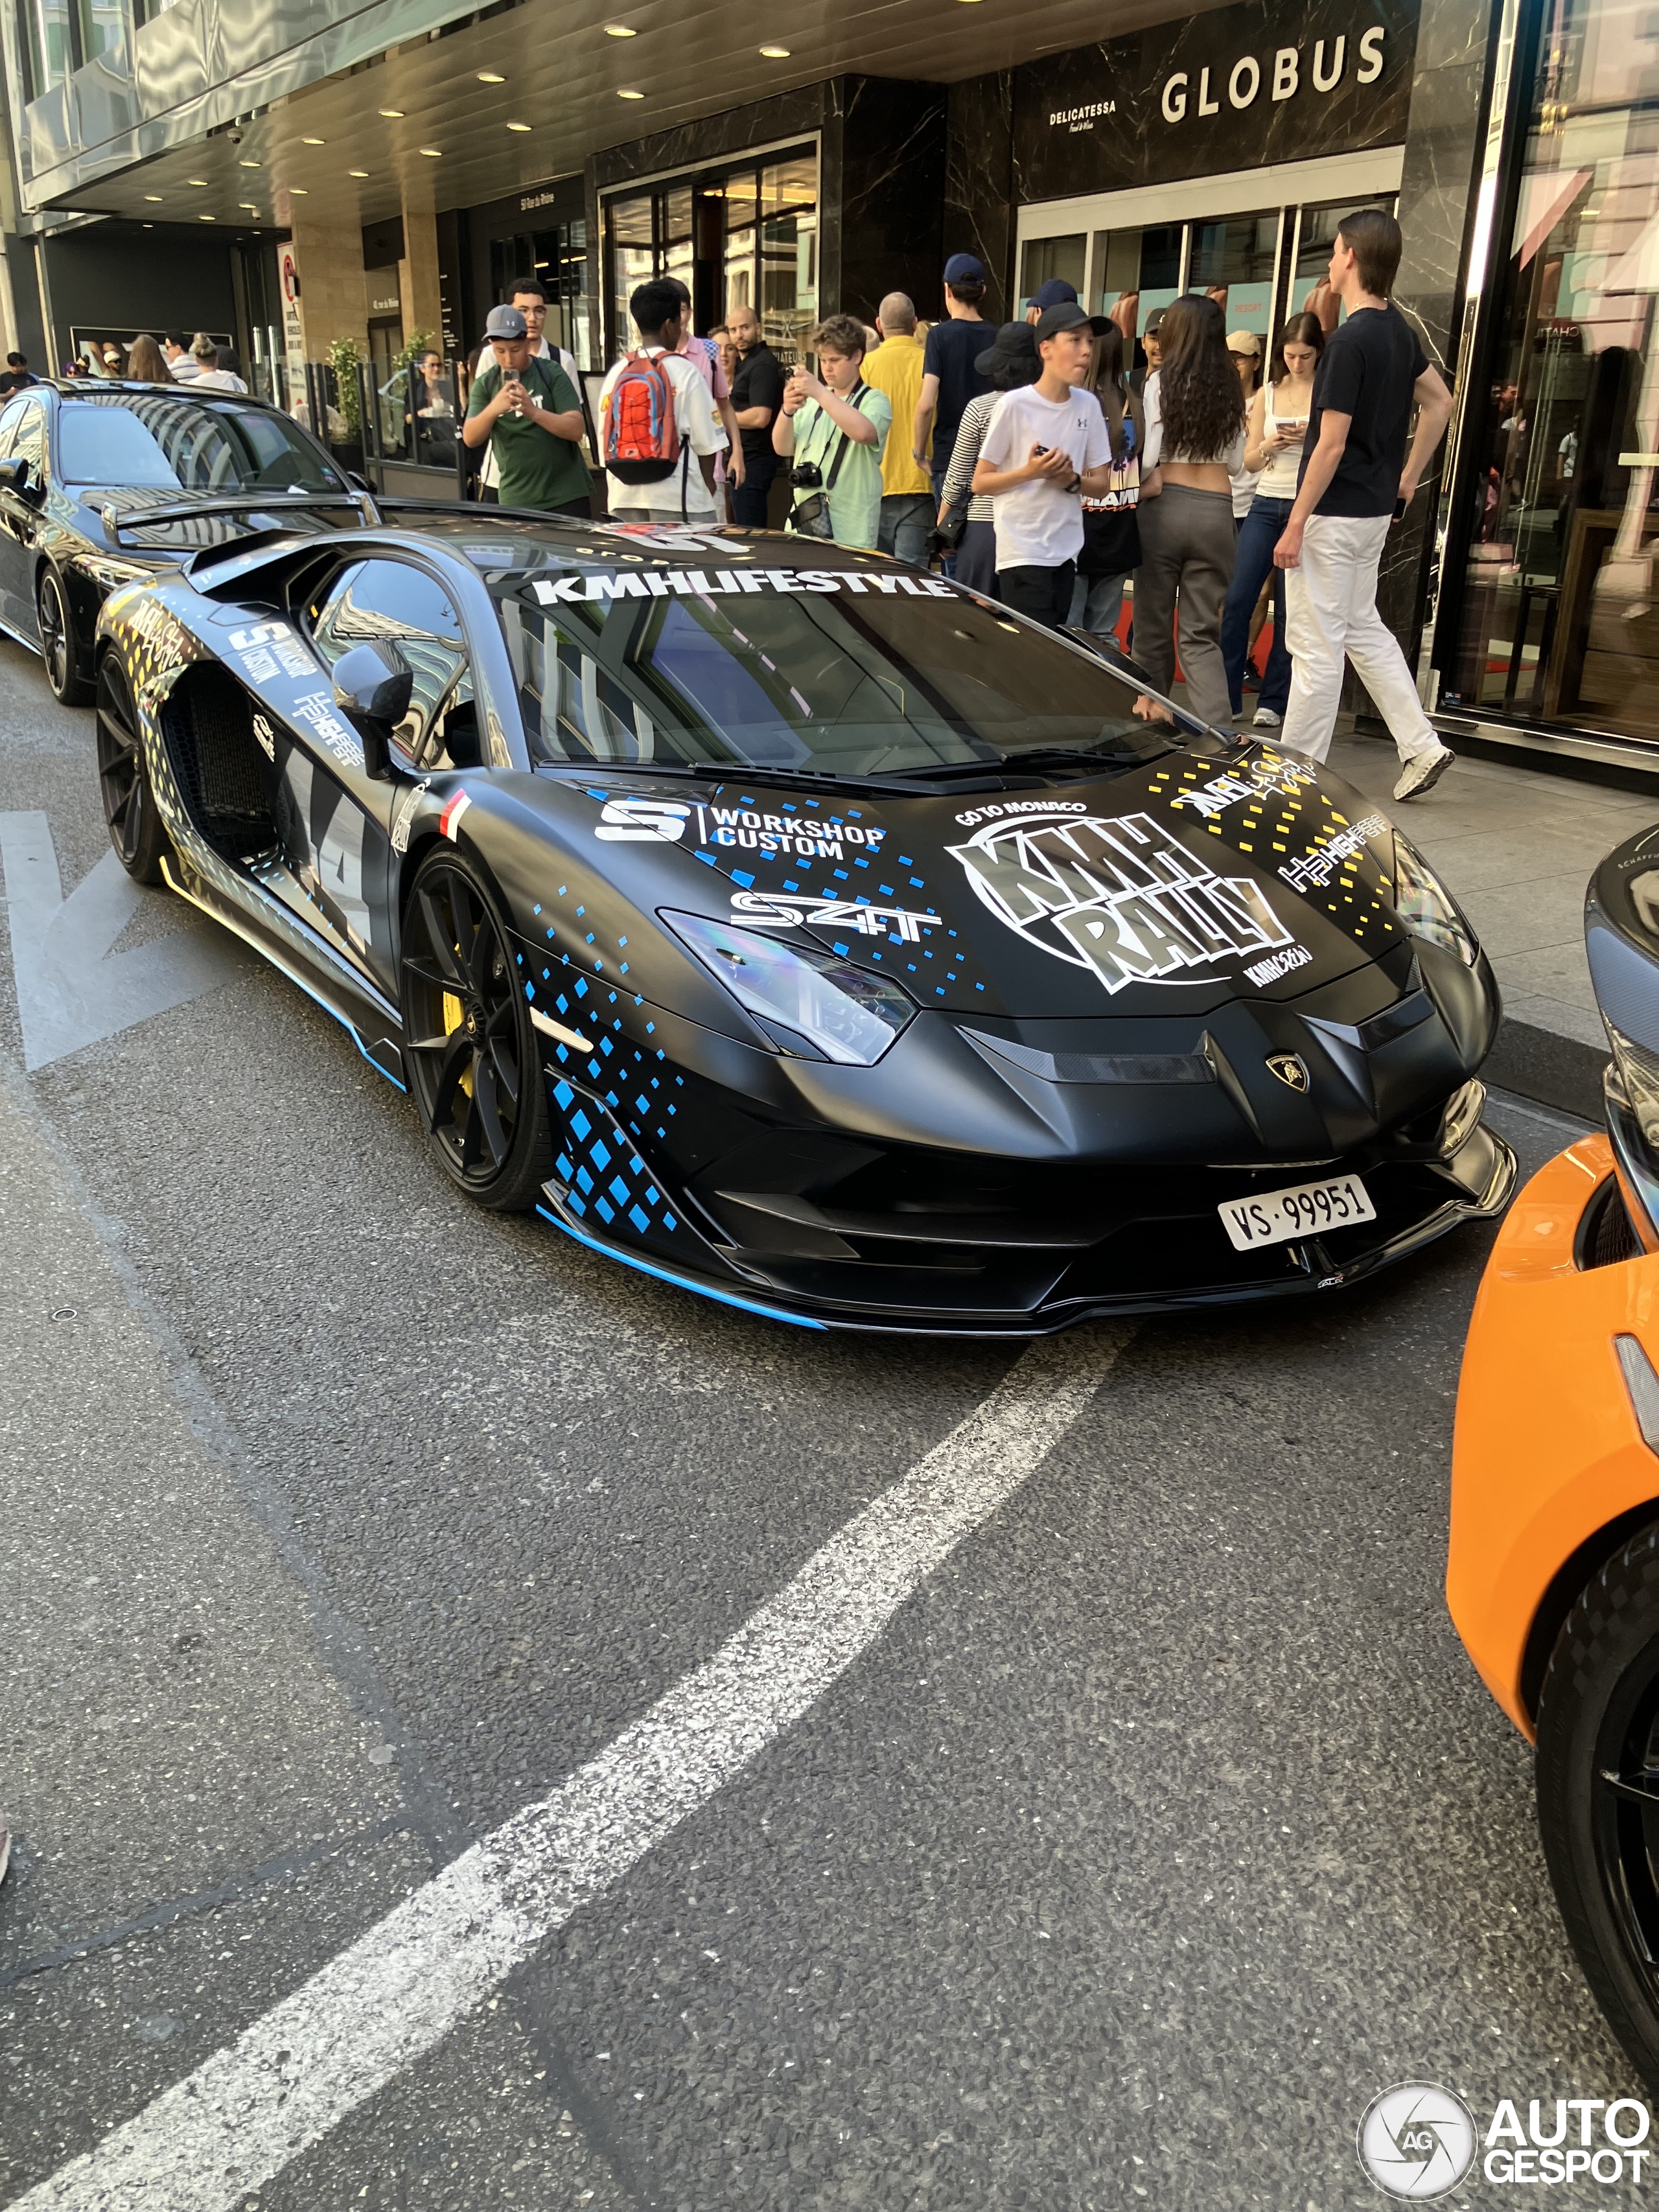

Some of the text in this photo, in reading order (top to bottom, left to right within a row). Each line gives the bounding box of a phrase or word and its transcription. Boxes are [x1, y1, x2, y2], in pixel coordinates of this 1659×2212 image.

[1162, 27, 1385, 123] GLOBUS
[1050, 100, 1116, 125] DELICATESSA
[532, 570, 959, 605] KMHLIFESTYLE
[241, 648, 281, 684] CUSTOM
[270, 638, 318, 679] WORKSHOP
[710, 807, 885, 845] WORKSHOP
[955, 801, 1087, 826] GO TO MONACO
[717, 827, 844, 861] CUSTOM
[944, 812, 1218, 927] KMH
[1050, 877, 1295, 995] RALLY
